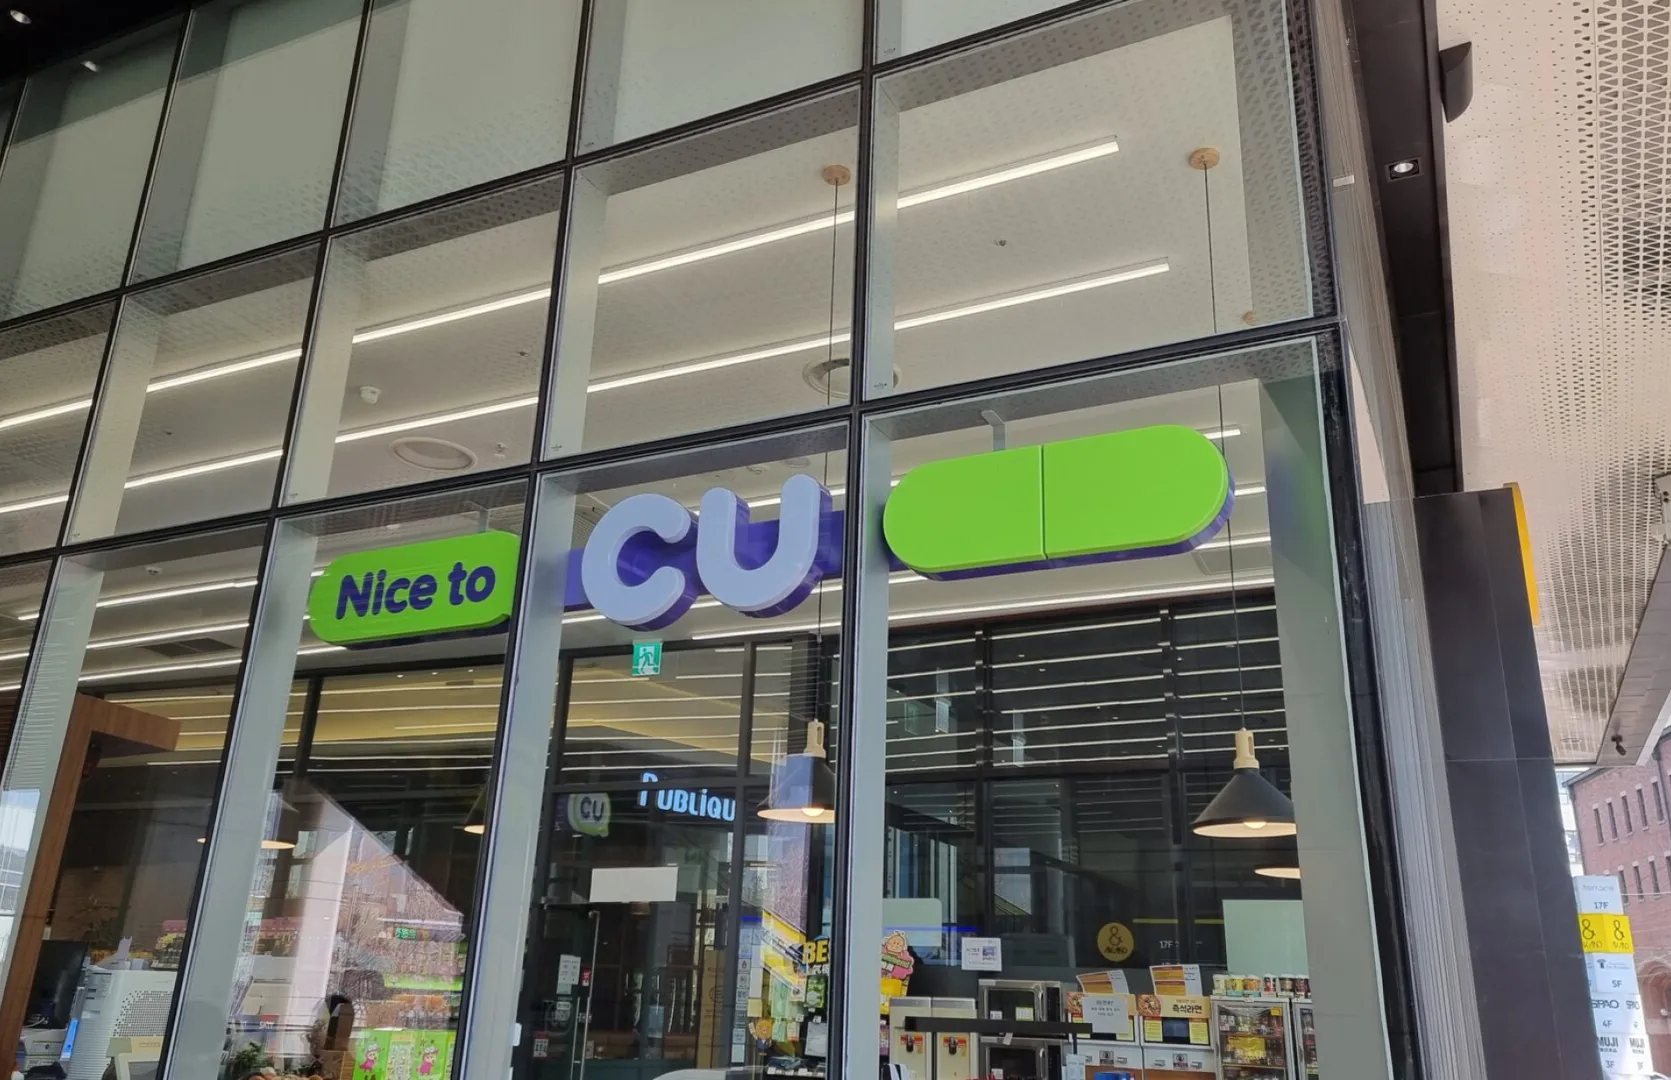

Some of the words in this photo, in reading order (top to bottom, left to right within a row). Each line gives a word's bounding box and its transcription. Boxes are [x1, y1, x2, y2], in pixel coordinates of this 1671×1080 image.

[581, 474, 824, 628] CU
[335, 569, 438, 620] Nice
[448, 561, 496, 606] to
[580, 796, 605, 821] CU
[1593, 902, 1609, 910] 17F
